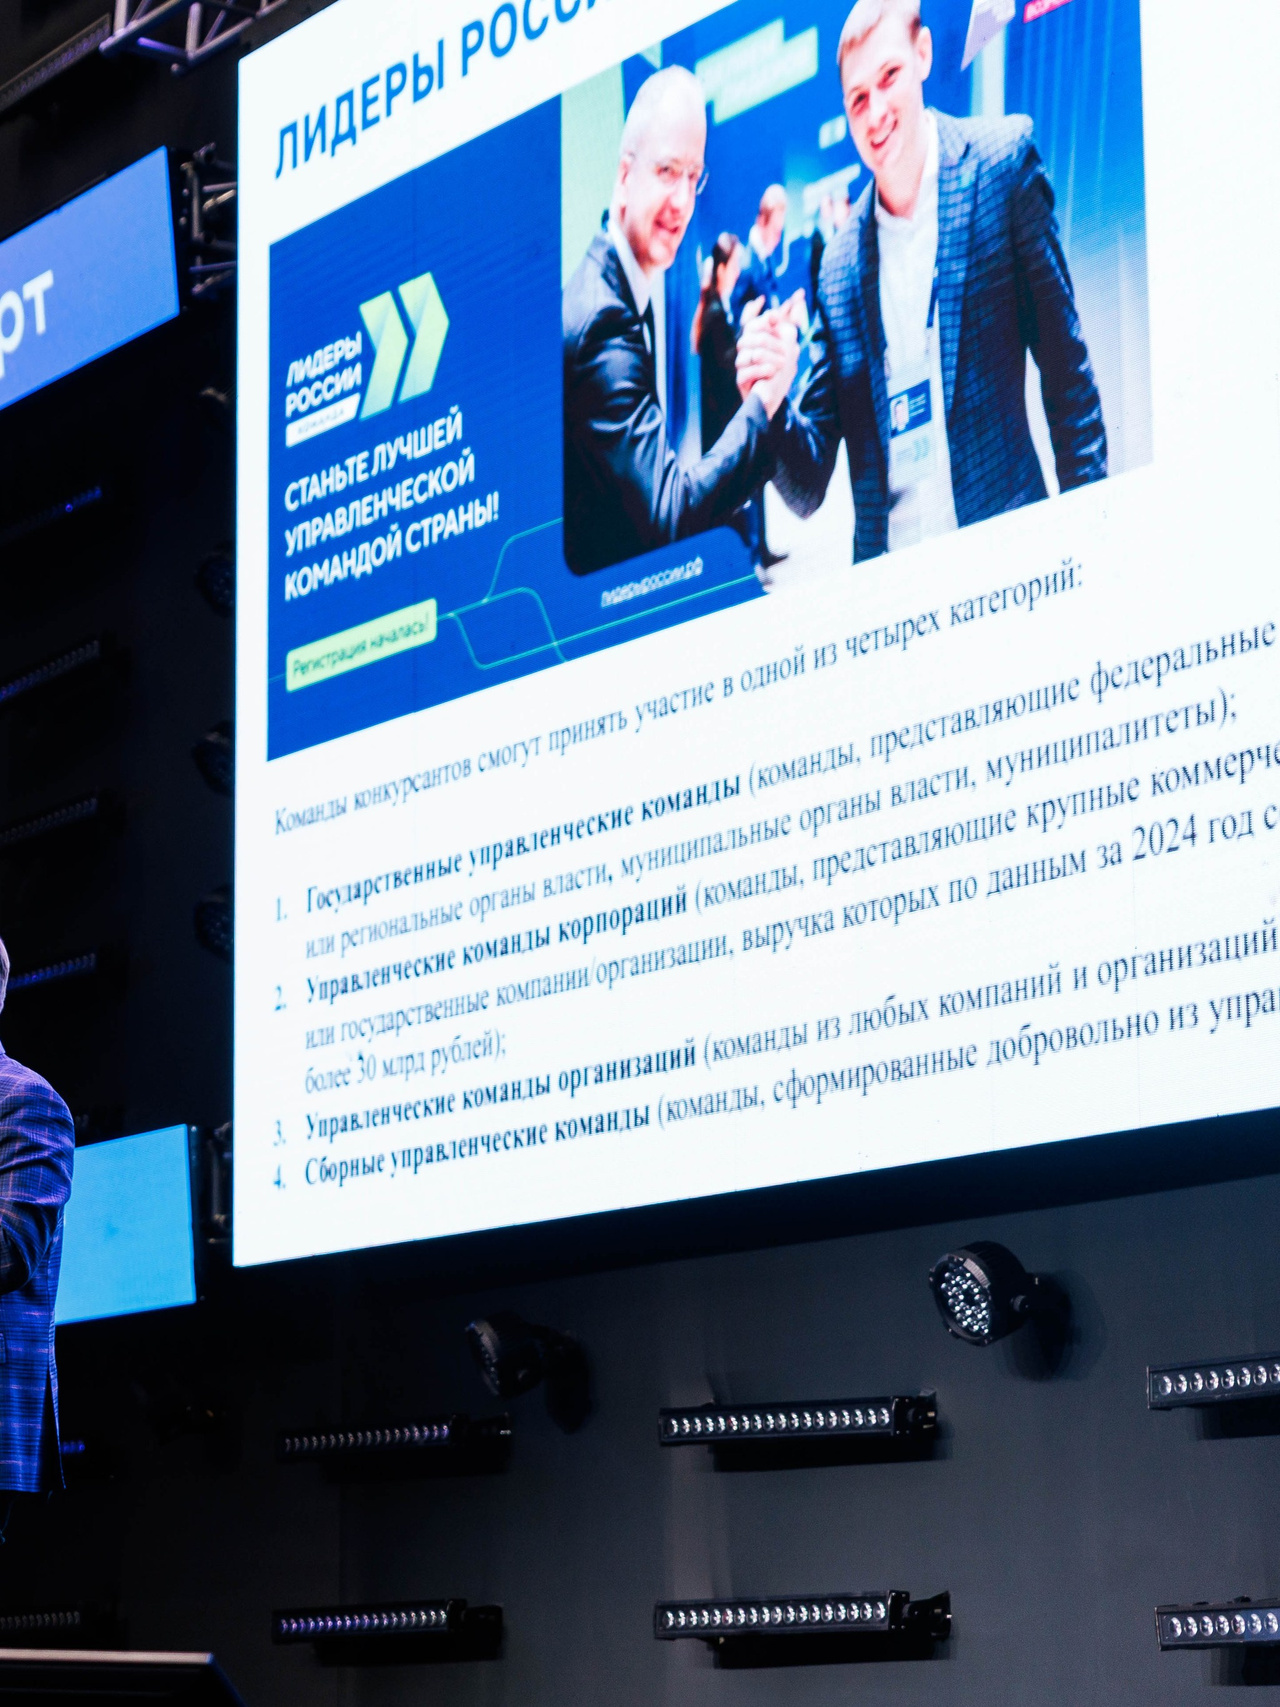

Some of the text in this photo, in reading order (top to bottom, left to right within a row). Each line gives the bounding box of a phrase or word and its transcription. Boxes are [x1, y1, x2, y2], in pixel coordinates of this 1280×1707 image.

[275, 37, 444, 179] ЛИДЕРЫ
[286, 331, 362, 388] ЛИДЕРЫ
[286, 362, 362, 418] РОССИИ
[284, 404, 462, 511] СТАНЬТЕ ЛУЧШЕЙ
[284, 446, 475, 556] УПРАВЛЕНЧЕСКОЙ
[284, 491, 499, 601] КОМАНДОЙ СТРАНЫ!
[275, 557, 1082, 835] Команды конкурсантов смогут принять участие в одной из четырех категорий:
[293, 639, 367, 678] Регистрация
[275, 620, 1277, 922] 1. Государственные управленческие команды (команды, представляющие федеральные
[306, 686, 1236, 958] или региональные органы власти, муниципальные органы власти, муниципалитеты);
[274, 984, 287, 1012] 2.
[307, 948, 456, 1005] Управленческие
[462, 925, 550, 967] команды
[558, 883, 687, 944] корпораций
[695, 864, 804, 916] (команды,
[812, 808, 1017, 886] представляющие
[1027, 776, 1140, 832] крупные
[305, 1024, 335, 1049] или
[341, 989, 489, 1042] государственные
[496, 933, 735, 1007] компании/организации,
[742, 910, 835, 953] выручка
[842, 885, 940, 929] которых
[948, 876, 977, 904] по
[986, 848, 1087, 897] данным
[1097, 840, 1122, 870] за
[1132, 812, 1197, 861] 2024
[1208, 809, 1255, 844] год
[273, 917, 1277, 1147] 3. Управленческие команды организаций (команды из любых компаний и организаций
[273, 986, 1280, 1191] 4. Сборные управленческие команды (команды, сформированные добровольно из упра
[305, 1027, 507, 1094] более 30 млрд рублей);
